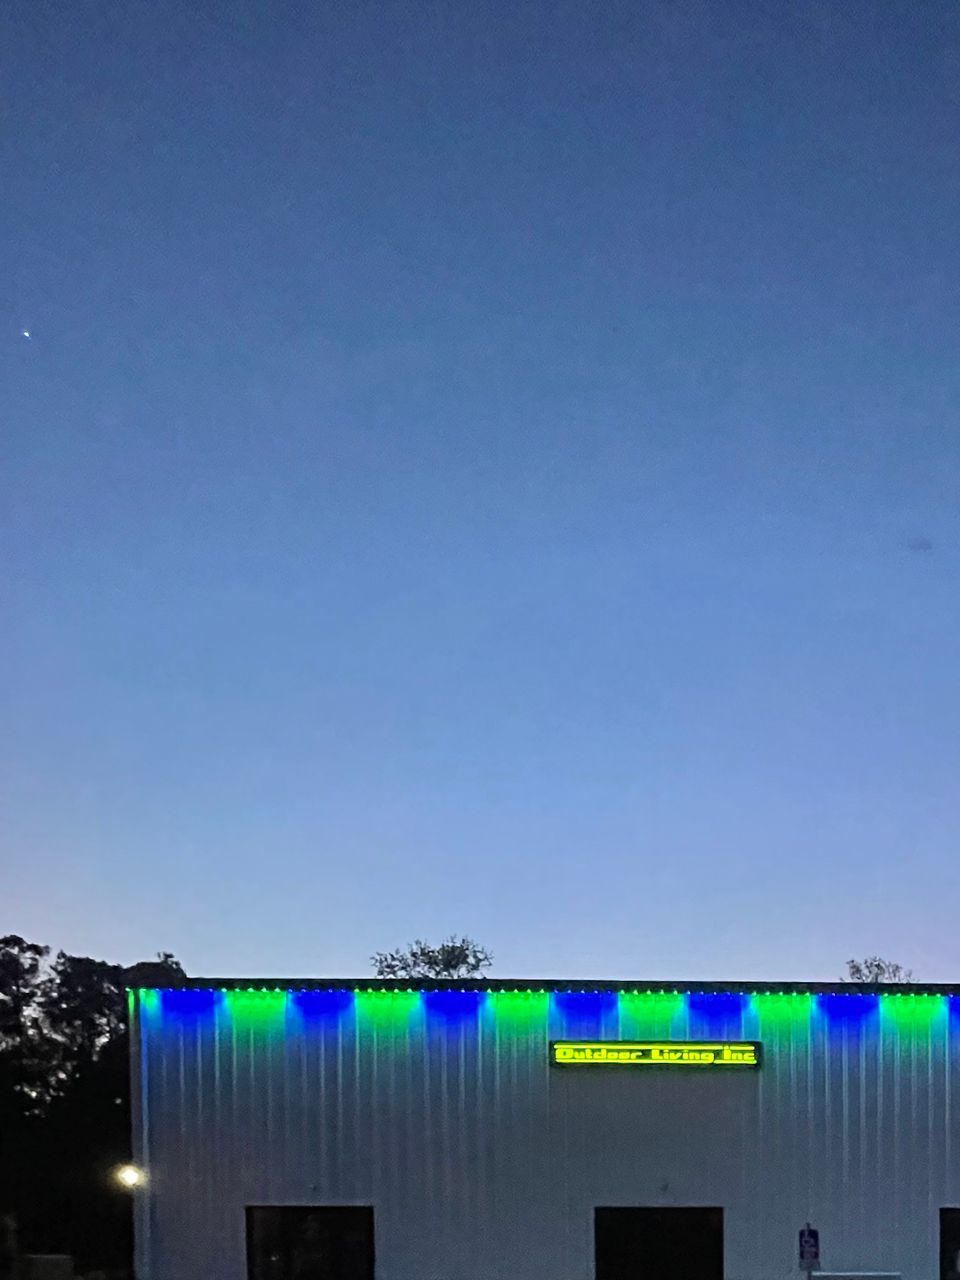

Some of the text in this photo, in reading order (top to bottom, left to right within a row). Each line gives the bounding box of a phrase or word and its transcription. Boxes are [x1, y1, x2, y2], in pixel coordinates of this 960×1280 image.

[555, 1046, 755, 1063] Outdoor Living Inc
